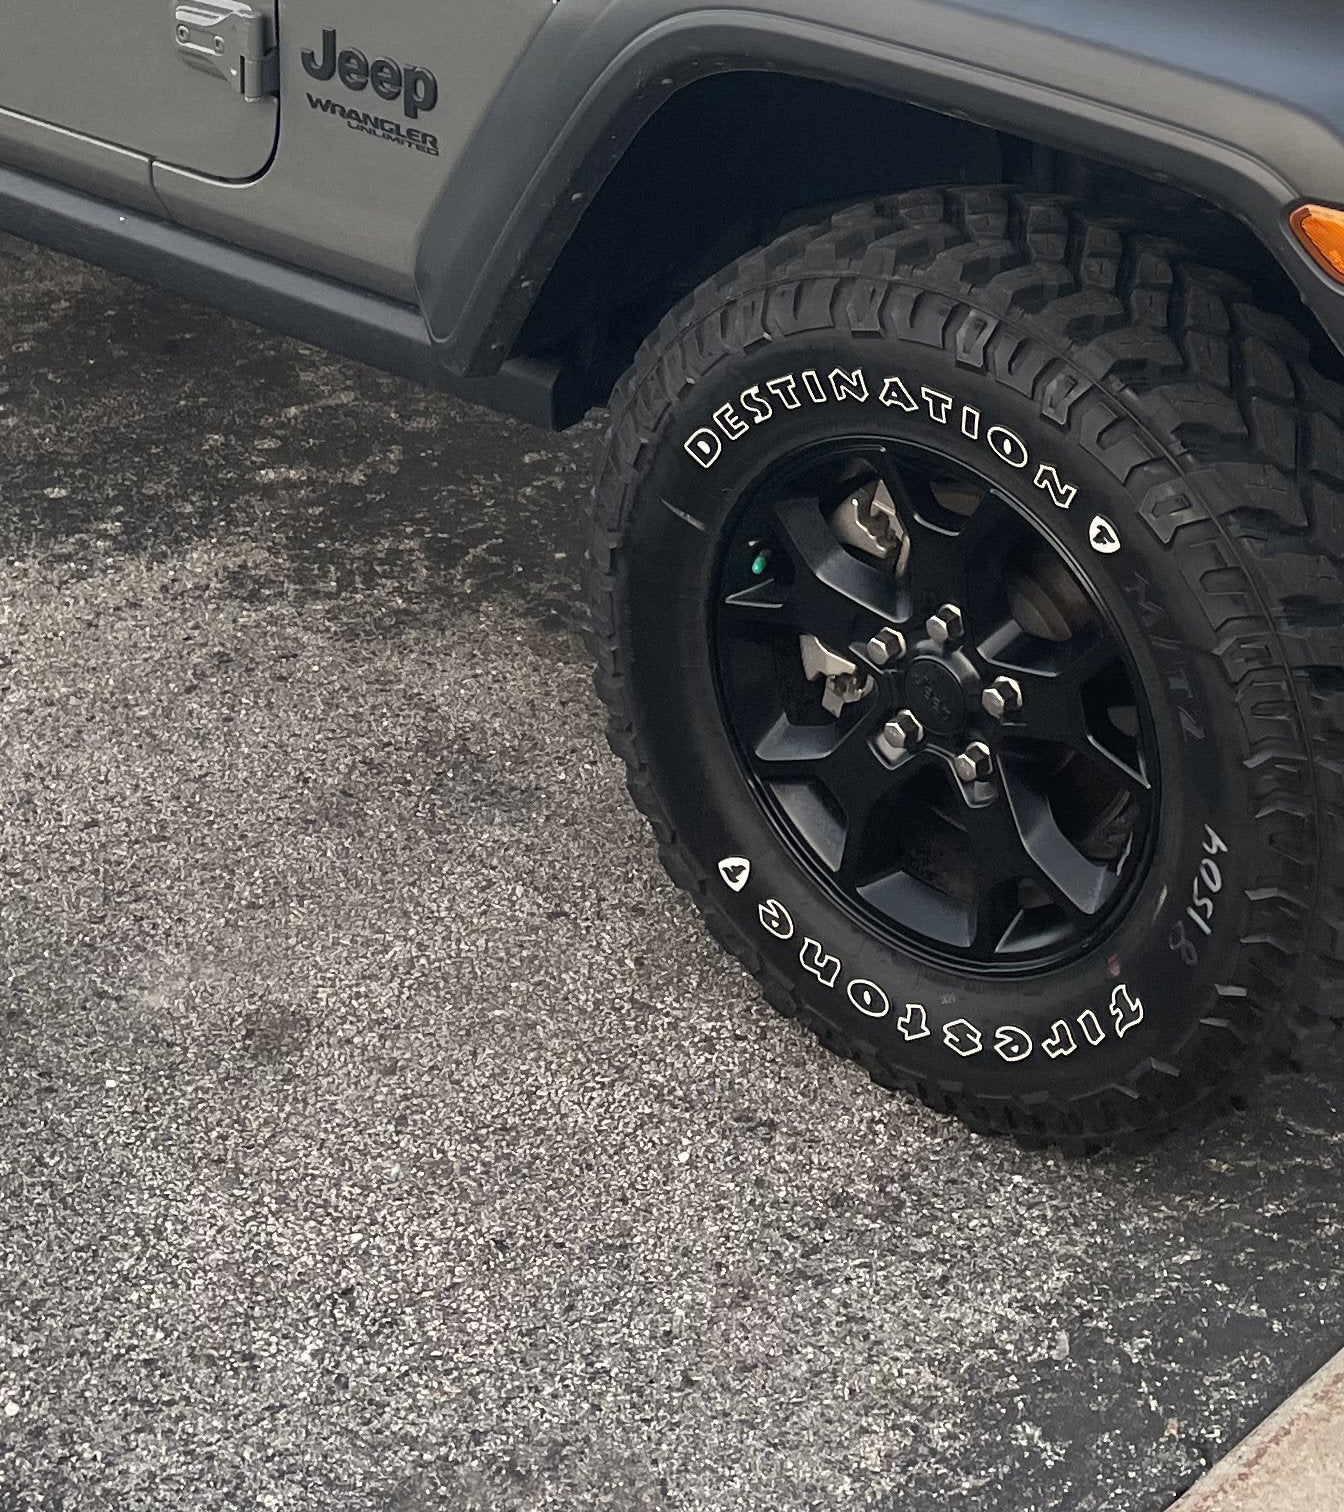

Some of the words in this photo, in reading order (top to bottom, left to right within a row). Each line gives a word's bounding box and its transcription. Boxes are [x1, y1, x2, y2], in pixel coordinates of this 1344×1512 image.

[301, 25, 438, 119] Jeep
[306, 92, 439, 149] WRANGLER
[347, 120, 439, 157] UNLIMITED
[683, 366, 1078, 510] DESTINATION
[758, 898, 1145, 1063] Firestone
